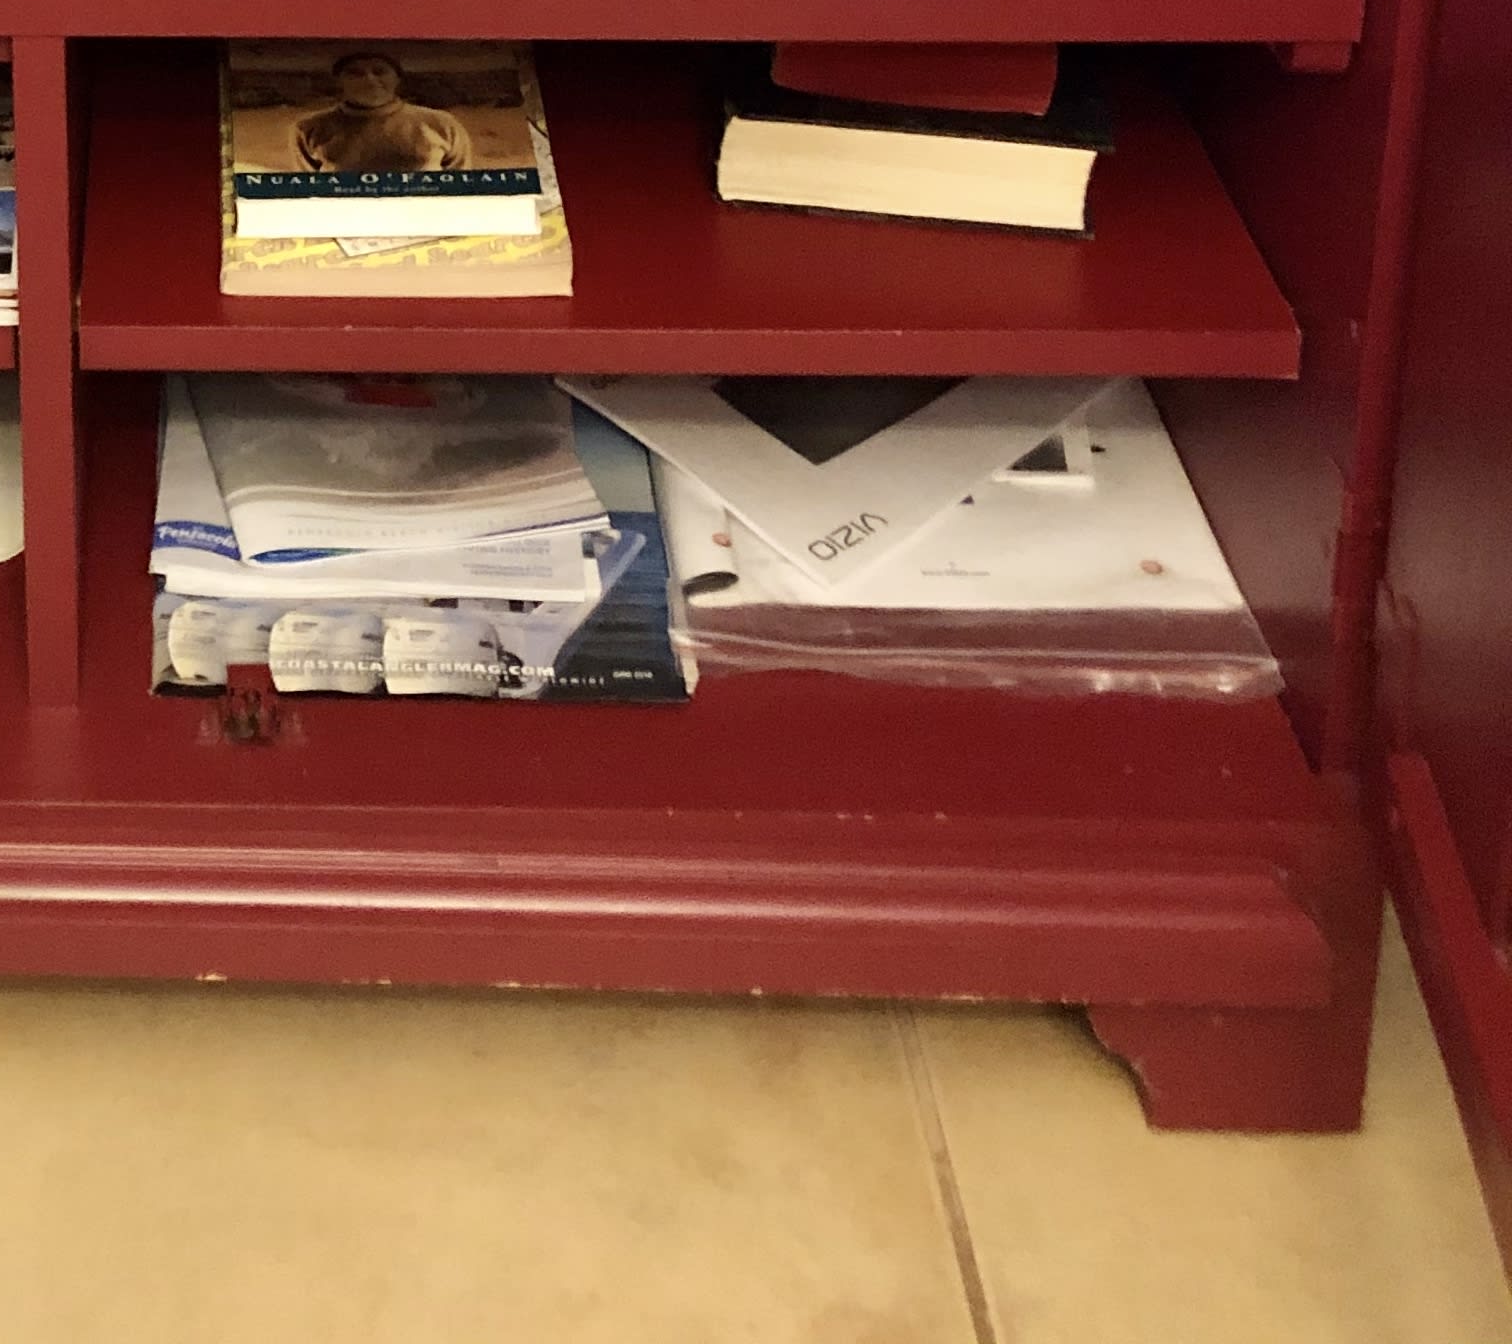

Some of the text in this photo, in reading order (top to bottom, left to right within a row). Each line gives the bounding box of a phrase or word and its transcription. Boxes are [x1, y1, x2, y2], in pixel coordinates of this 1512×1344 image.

[246, 171, 530, 186] NUALA O'FAOLAIN
[334, 184, 440, 195] Read by the author
[806, 510, 890, 562] VIZIO
[276, 657, 555, 679] COASTALANGLERMAG.COM
